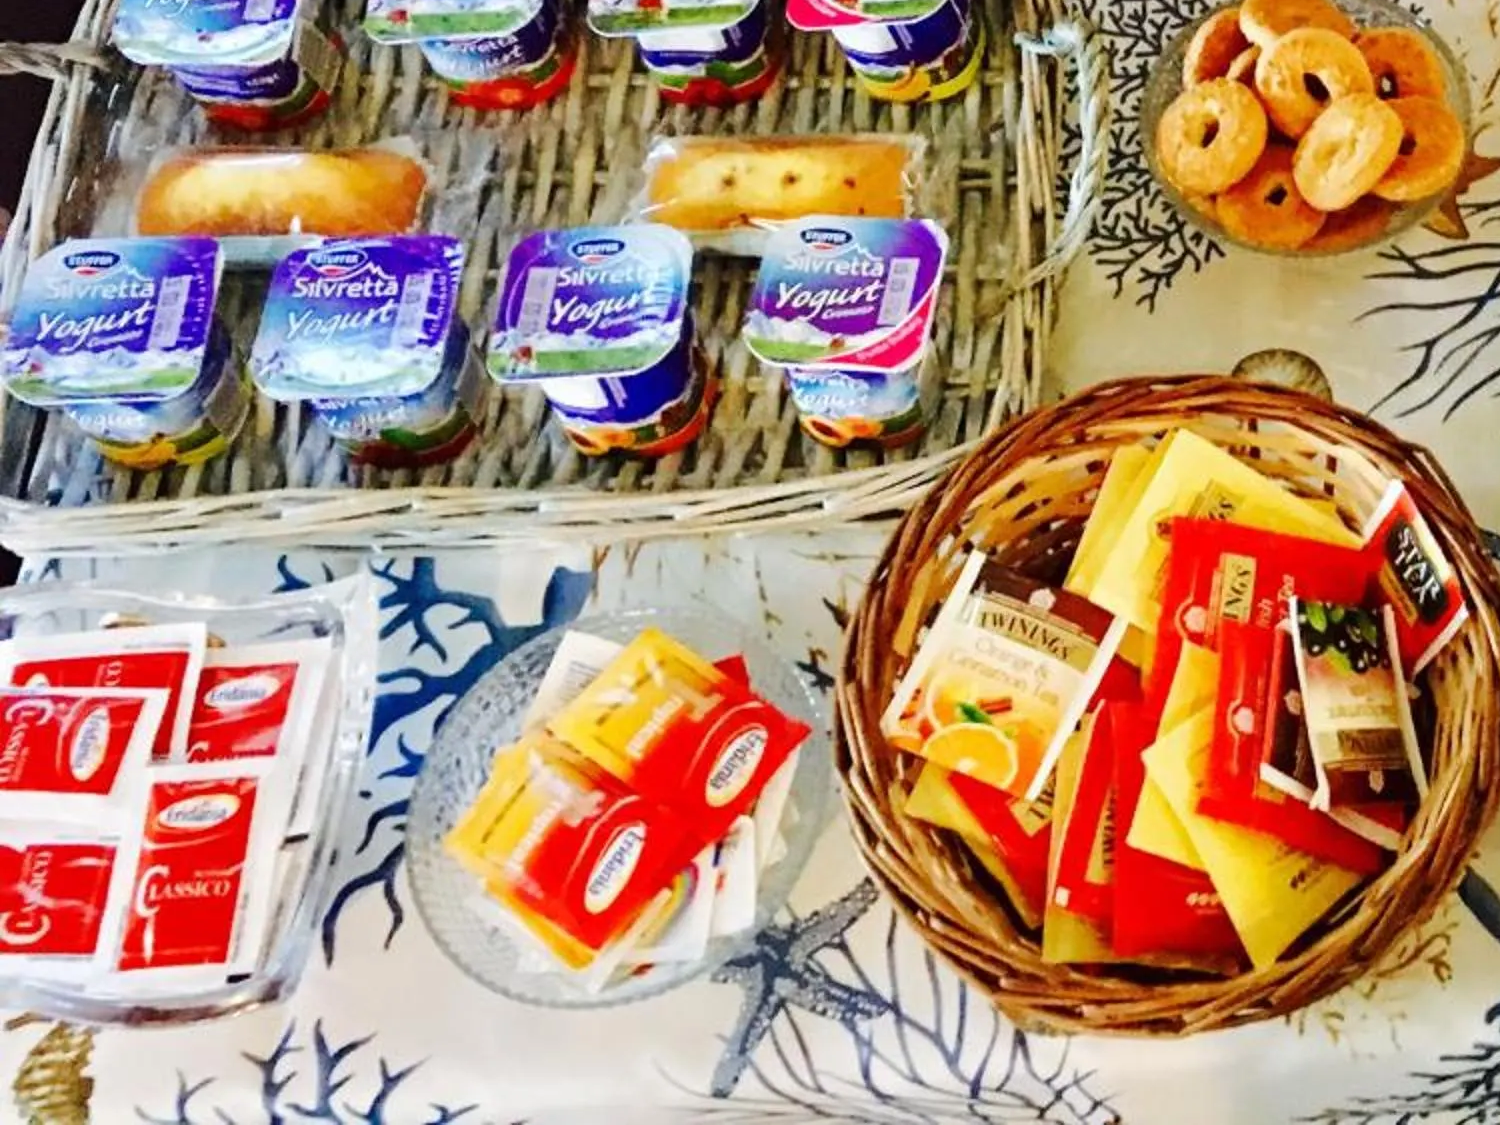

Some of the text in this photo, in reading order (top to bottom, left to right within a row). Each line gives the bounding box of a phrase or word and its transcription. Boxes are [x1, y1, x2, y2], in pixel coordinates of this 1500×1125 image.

[48, 276, 155, 299] Silvretta
[292, 276, 398, 299] Silvretta
[785, 254, 885, 277] Silvretta
[551, 287, 654, 331] Yogurt
[777, 279, 888, 318] Yogurt
[37, 303, 155, 350] Yogurt
[286, 299, 400, 344] Yogurt
[979, 610, 1070, 663] TWININGS
[709, 734, 765, 789] Eridania
[587, 828, 647, 898] Eridania
[135, 865, 232, 918] CLASSICO
